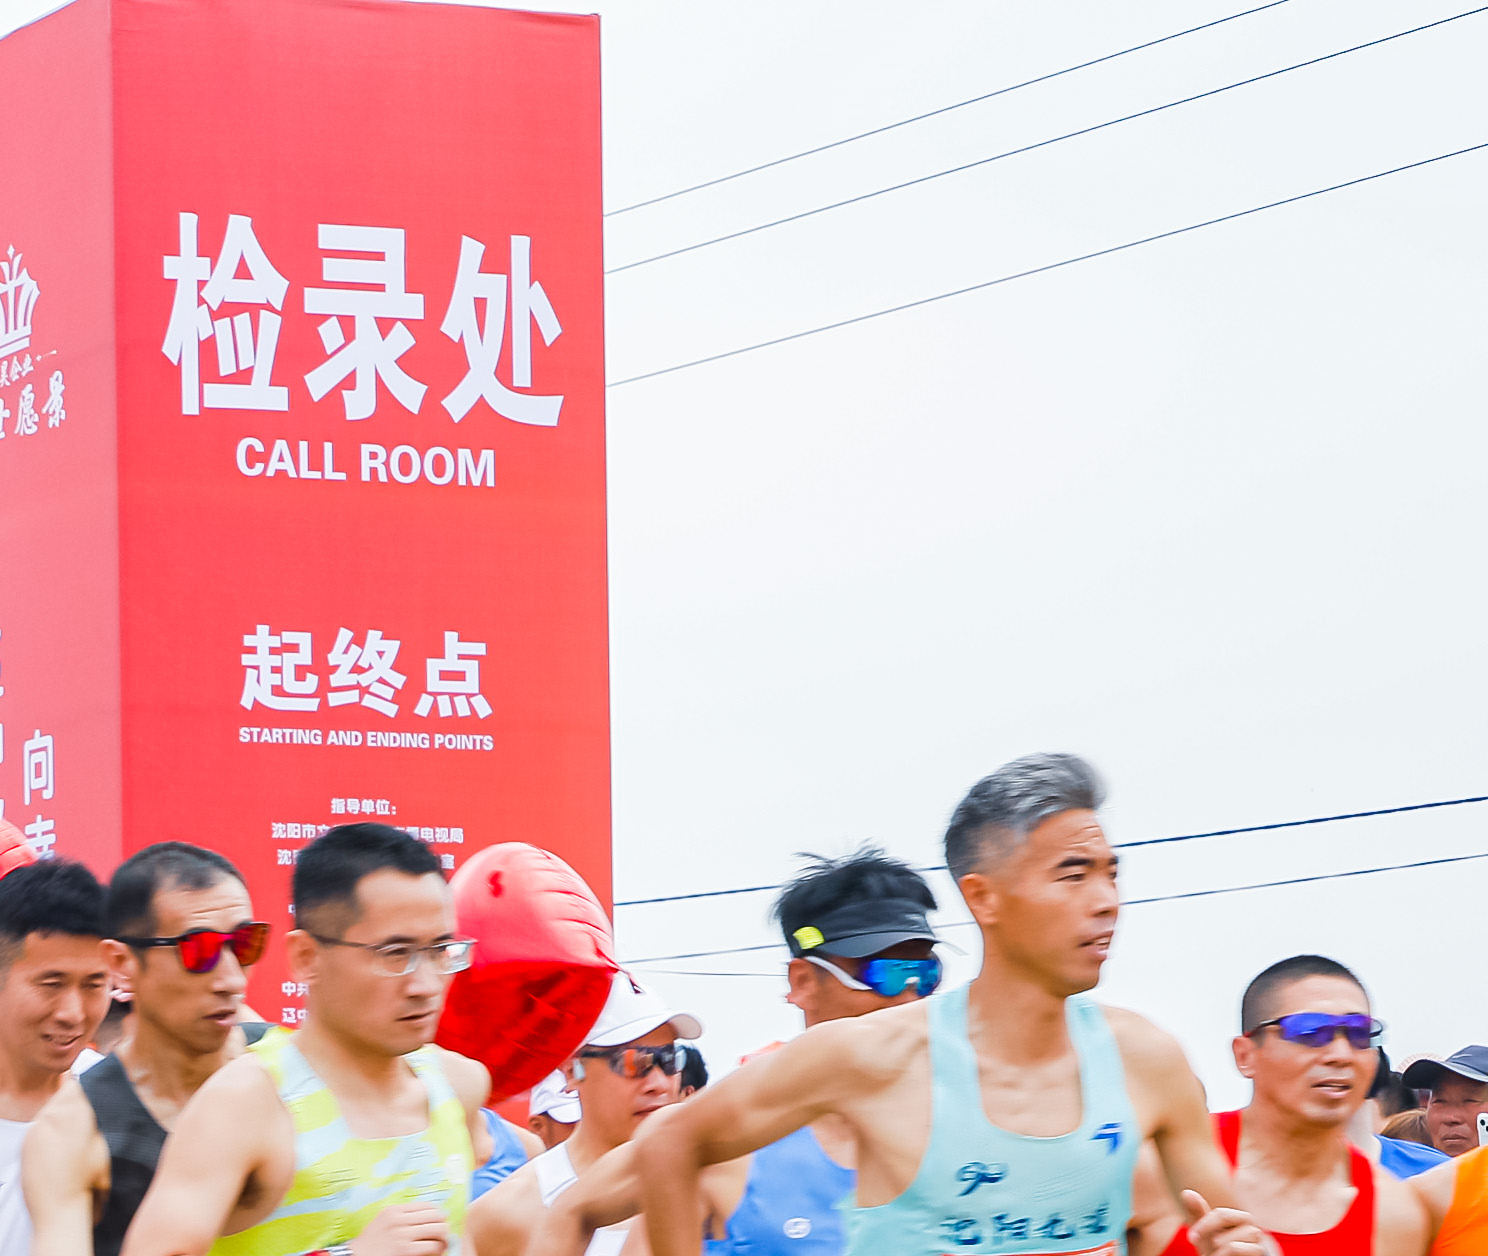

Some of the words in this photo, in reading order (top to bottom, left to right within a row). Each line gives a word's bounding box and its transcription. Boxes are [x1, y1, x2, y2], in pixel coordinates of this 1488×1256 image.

[161, 211, 565, 427] 检录处
[236, 436, 347, 481] CALL
[360, 443, 496, 487] ROOM
[239, 624, 497, 720] 起终点
[238, 726, 322, 746] STARTING
[327, 729, 363, 747] AND
[366, 730, 430, 749] ENDING
[434, 732, 495, 751] POINTS
